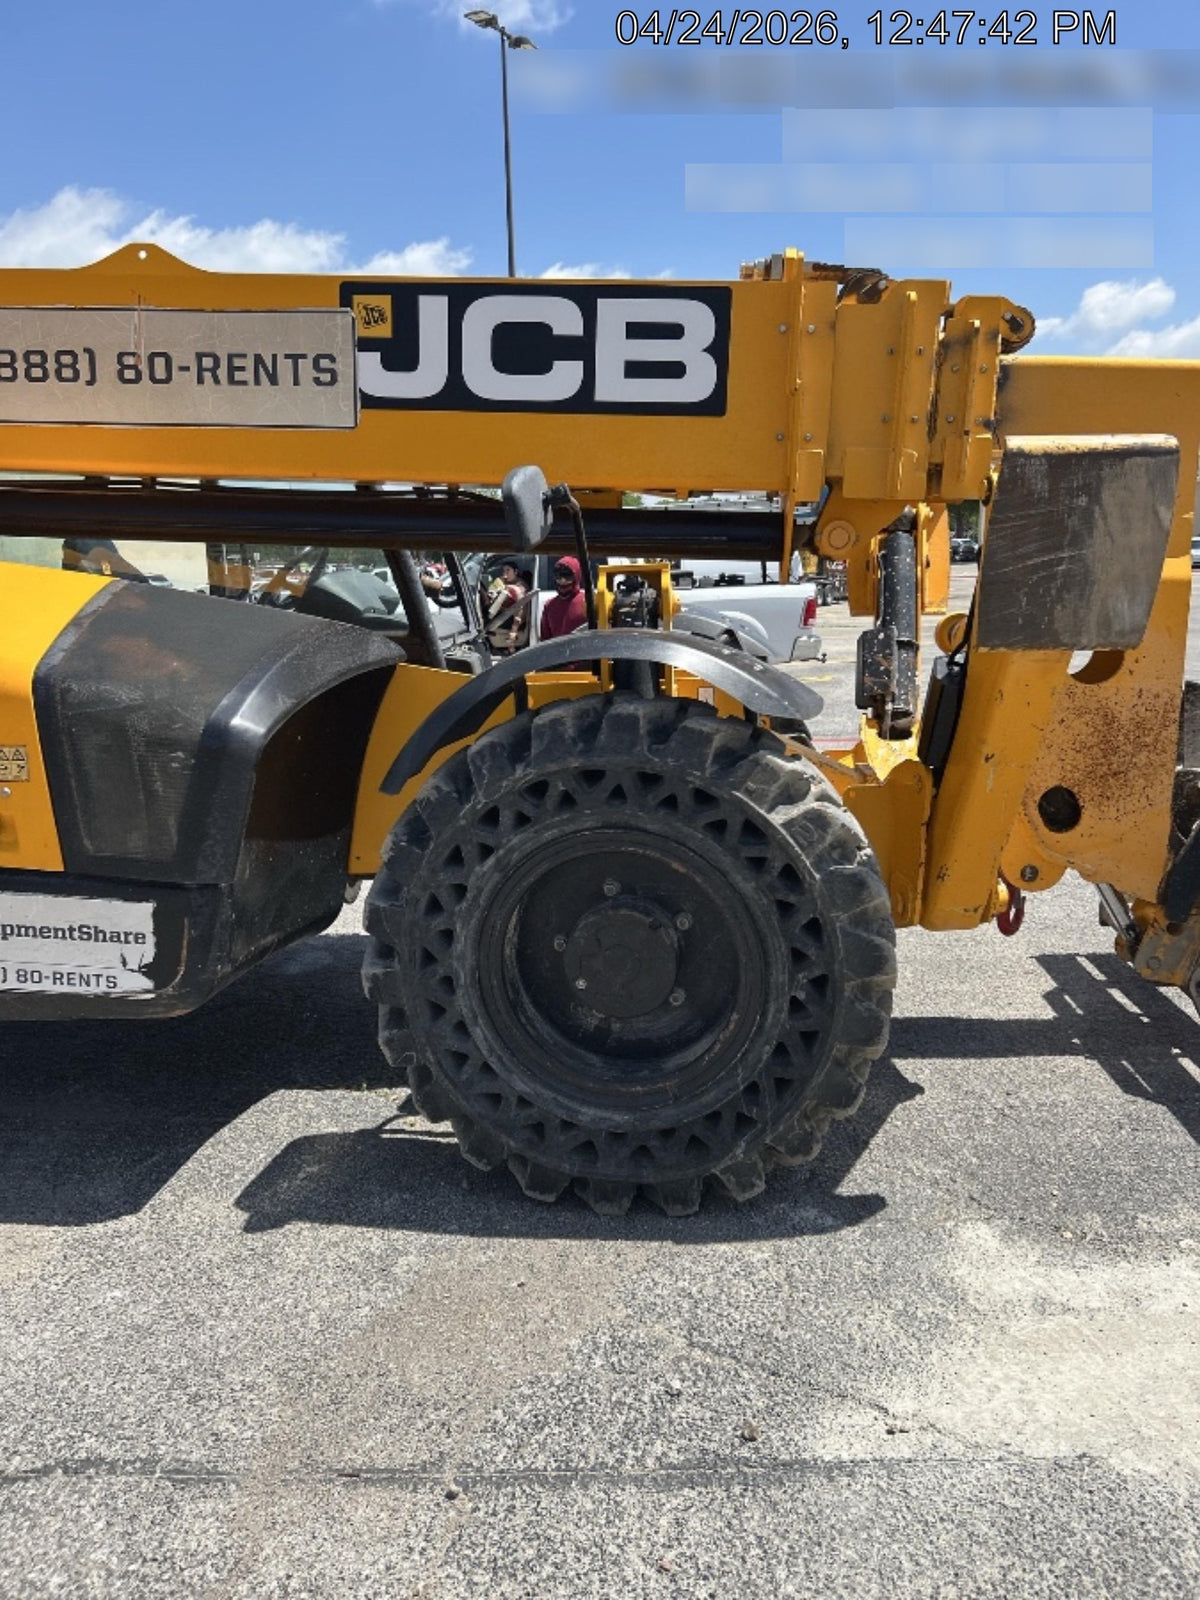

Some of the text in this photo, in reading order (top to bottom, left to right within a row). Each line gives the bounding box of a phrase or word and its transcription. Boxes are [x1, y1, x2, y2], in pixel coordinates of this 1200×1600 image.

[358, 294, 717, 403] JCB
[117, 351, 339, 387] 80-RENTS
[16, 968, 118, 990] 80-RENTS
